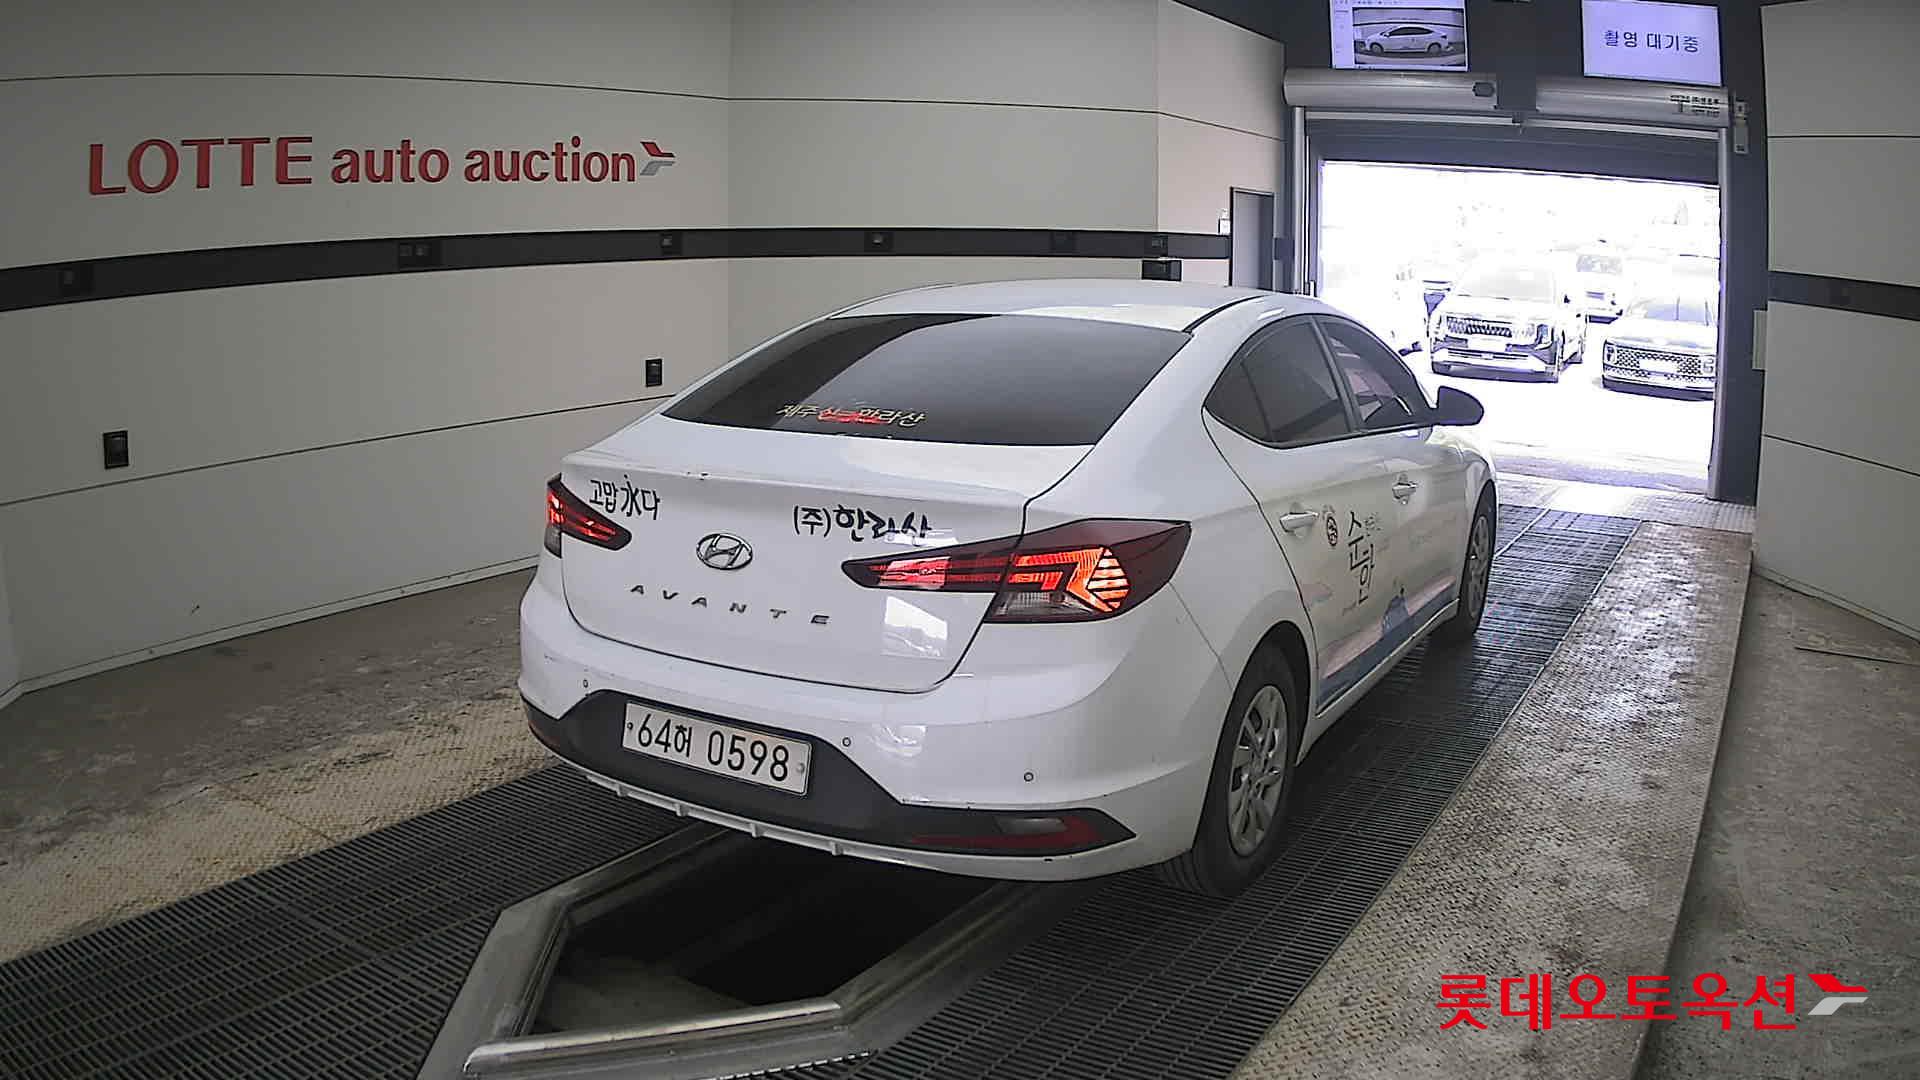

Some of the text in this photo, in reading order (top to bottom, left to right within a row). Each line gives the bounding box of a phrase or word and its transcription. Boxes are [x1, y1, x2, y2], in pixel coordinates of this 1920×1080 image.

[603, 30, 699, 53] 촬영 대기중
[88, 136, 637, 196] LOTTE auto auction
[630, 583, 831, 626] AVANTE
[637, 713, 790, 782] 64허 0598
